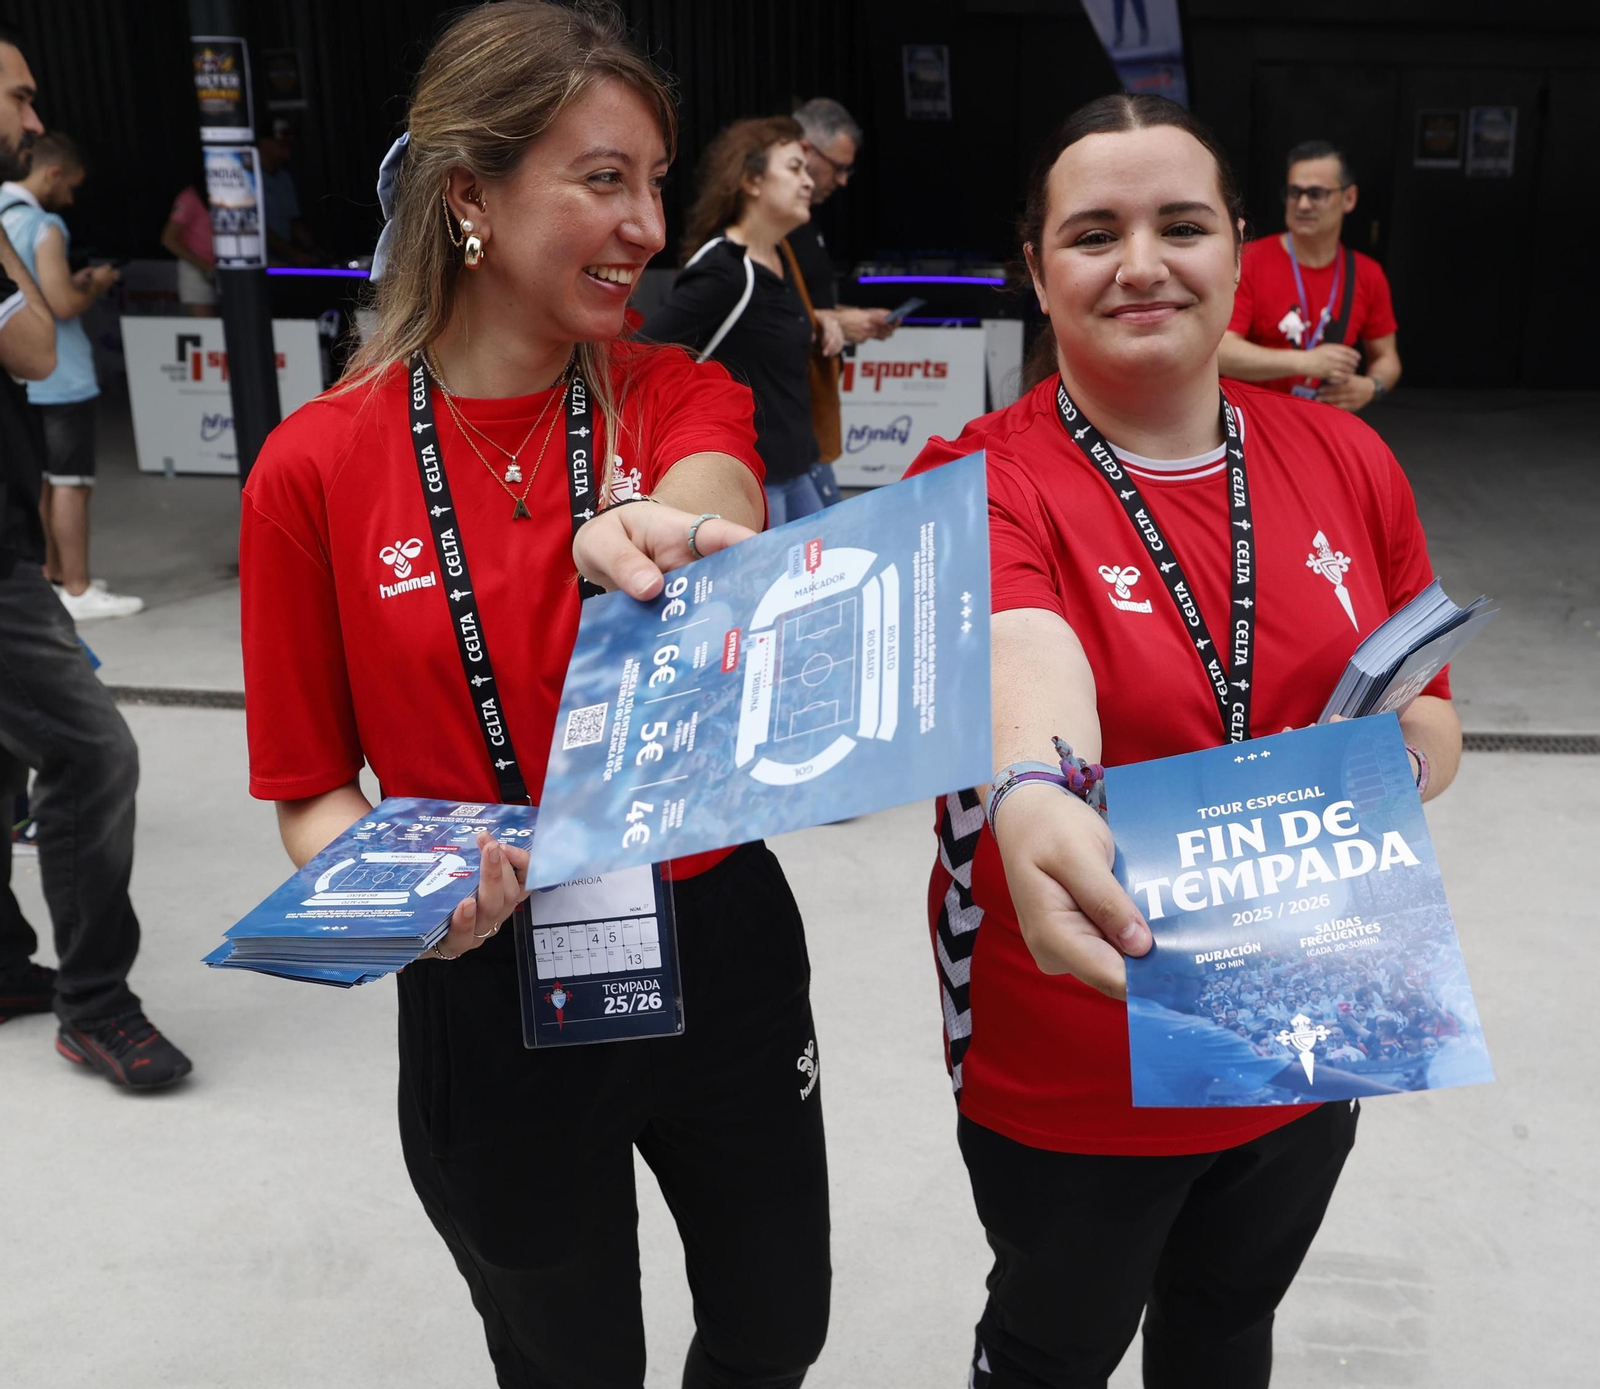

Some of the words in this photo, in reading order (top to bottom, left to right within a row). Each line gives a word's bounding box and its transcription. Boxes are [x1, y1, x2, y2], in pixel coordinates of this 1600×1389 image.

[413, 366, 426, 410] CELTA
[860, 360, 948, 392] sports
[572, 377, 586, 416] CELTA
[1057, 385, 1077, 422] CELTA
[1224, 400, 1238, 438] CELTA
[421, 444, 442, 492] CELTA
[572, 449, 588, 496] CELTA
[1090, 442, 1122, 480] CELTA
[1232, 467, 1246, 508] CELTA
[512, 498, 532, 519] A
[1134, 508, 1164, 551] CELTA
[440, 528, 462, 577] CELTA
[810, 542, 821, 568] SAÍDA
[1236, 540, 1250, 584] CELTA
[380, 572, 436, 599] hummel
[662, 576, 688, 621] 9€
[794, 572, 846, 598] MARCADOR
[1174, 581, 1200, 626] CELTA
[460, 612, 482, 662] CELTA
[867, 630, 875, 648] RIO
[888, 625, 896, 643] RIO
[1234, 620, 1249, 666] CELTA
[649, 645, 679, 688] 6€
[726, 632, 737, 670] ENTRADA
[866, 649, 875, 680] BAIXO
[887, 645, 896, 670] ALTO
[617, 658, 633, 708] BILLETEIRAS
[628, 662, 640, 690] MERCA
[750, 671, 761, 712] TRIBUNA
[482, 698, 504, 746] CELTA
[615, 708, 622, 721] OU
[624, 697, 634, 715] TÚA
[608, 722, 621, 760] ESCANEA
[616, 715, 630, 755] ENTRADA
[636, 722, 668, 766] 5€
[603, 768, 612, 781] QR
[614, 754, 624, 773] NAS
[793, 764, 813, 777] GOL
[1197, 802, 1243, 819] TOUR
[1246, 786, 1325, 810] ESPECIAL
[359, 822, 392, 831] 4€
[406, 823, 439, 833] 5€
[456, 826, 488, 834] 6€
[500, 828, 533, 837] 9€
[622, 800, 654, 848] 4€
[1176, 818, 1266, 868] FIN
[1279, 800, 1360, 847] DE
[1134, 830, 1421, 920] TEMPADA
[1232, 907, 1273, 926] 2025
[1289, 894, 1330, 915] 2026
[1315, 916, 1363, 935] SAÍDAS
[540, 938, 546, 950] 1
[557, 937, 564, 947] 2
[592, 933, 599, 944] 4
[609, 932, 616, 942] 5
[1300, 922, 1382, 948] FRECUENTES
[628, 954, 642, 965] 13
[1195, 942, 1262, 964] DURACIÓN
[1215, 962, 1226, 971] 30
[1228, 959, 1245, 968] MIN
[1306, 945, 1333, 958] (CADA
[602, 979, 660, 995] TEMPADA
[604, 992, 662, 1014] 25/26
